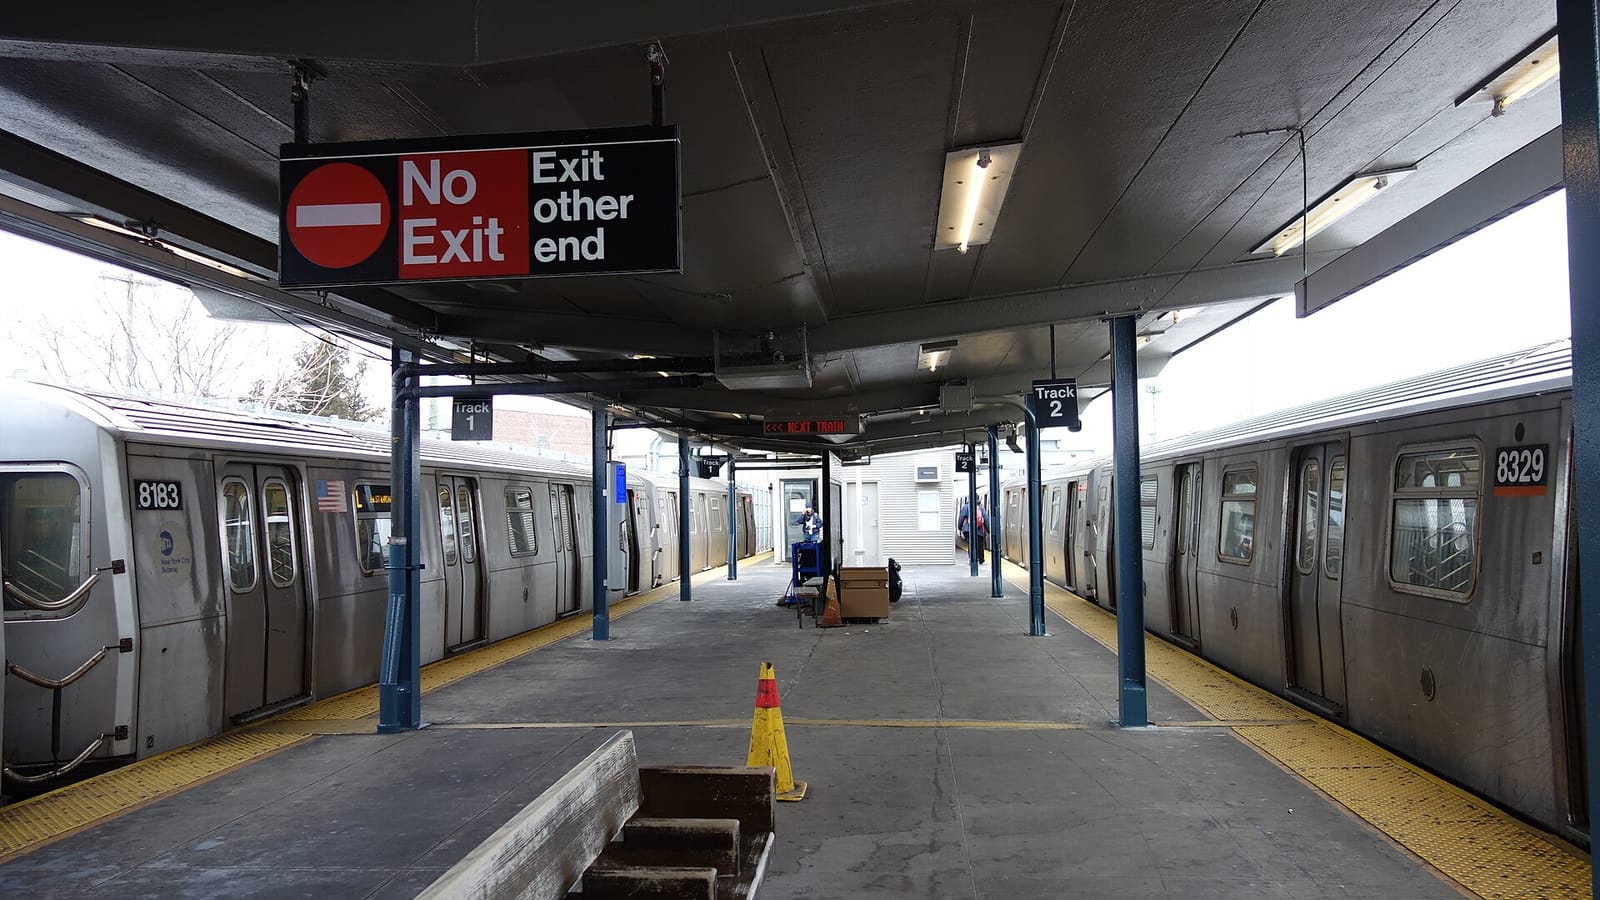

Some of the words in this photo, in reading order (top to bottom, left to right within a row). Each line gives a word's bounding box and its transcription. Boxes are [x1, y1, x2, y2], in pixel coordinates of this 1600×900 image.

[532, 150, 605, 184] Exit
[402, 159, 477, 206] No
[533, 188, 634, 224] other
[403, 215, 505, 265] Exit
[534, 227, 605, 263] end
[1035, 385, 1076, 400] Track
[453, 401, 490, 413] Track
[1050, 400, 1063, 417] 2
[466, 415, 474, 431] 1
[788, 420, 811, 433] NEXT
[816, 420, 844, 433] TRAIN
[708, 465, 713, 473] 1
[961, 461, 968, 469] 2
[1496, 448, 1545, 484] 8329
[138, 482, 179, 508] 8183
[355, 489, 363, 508] L
